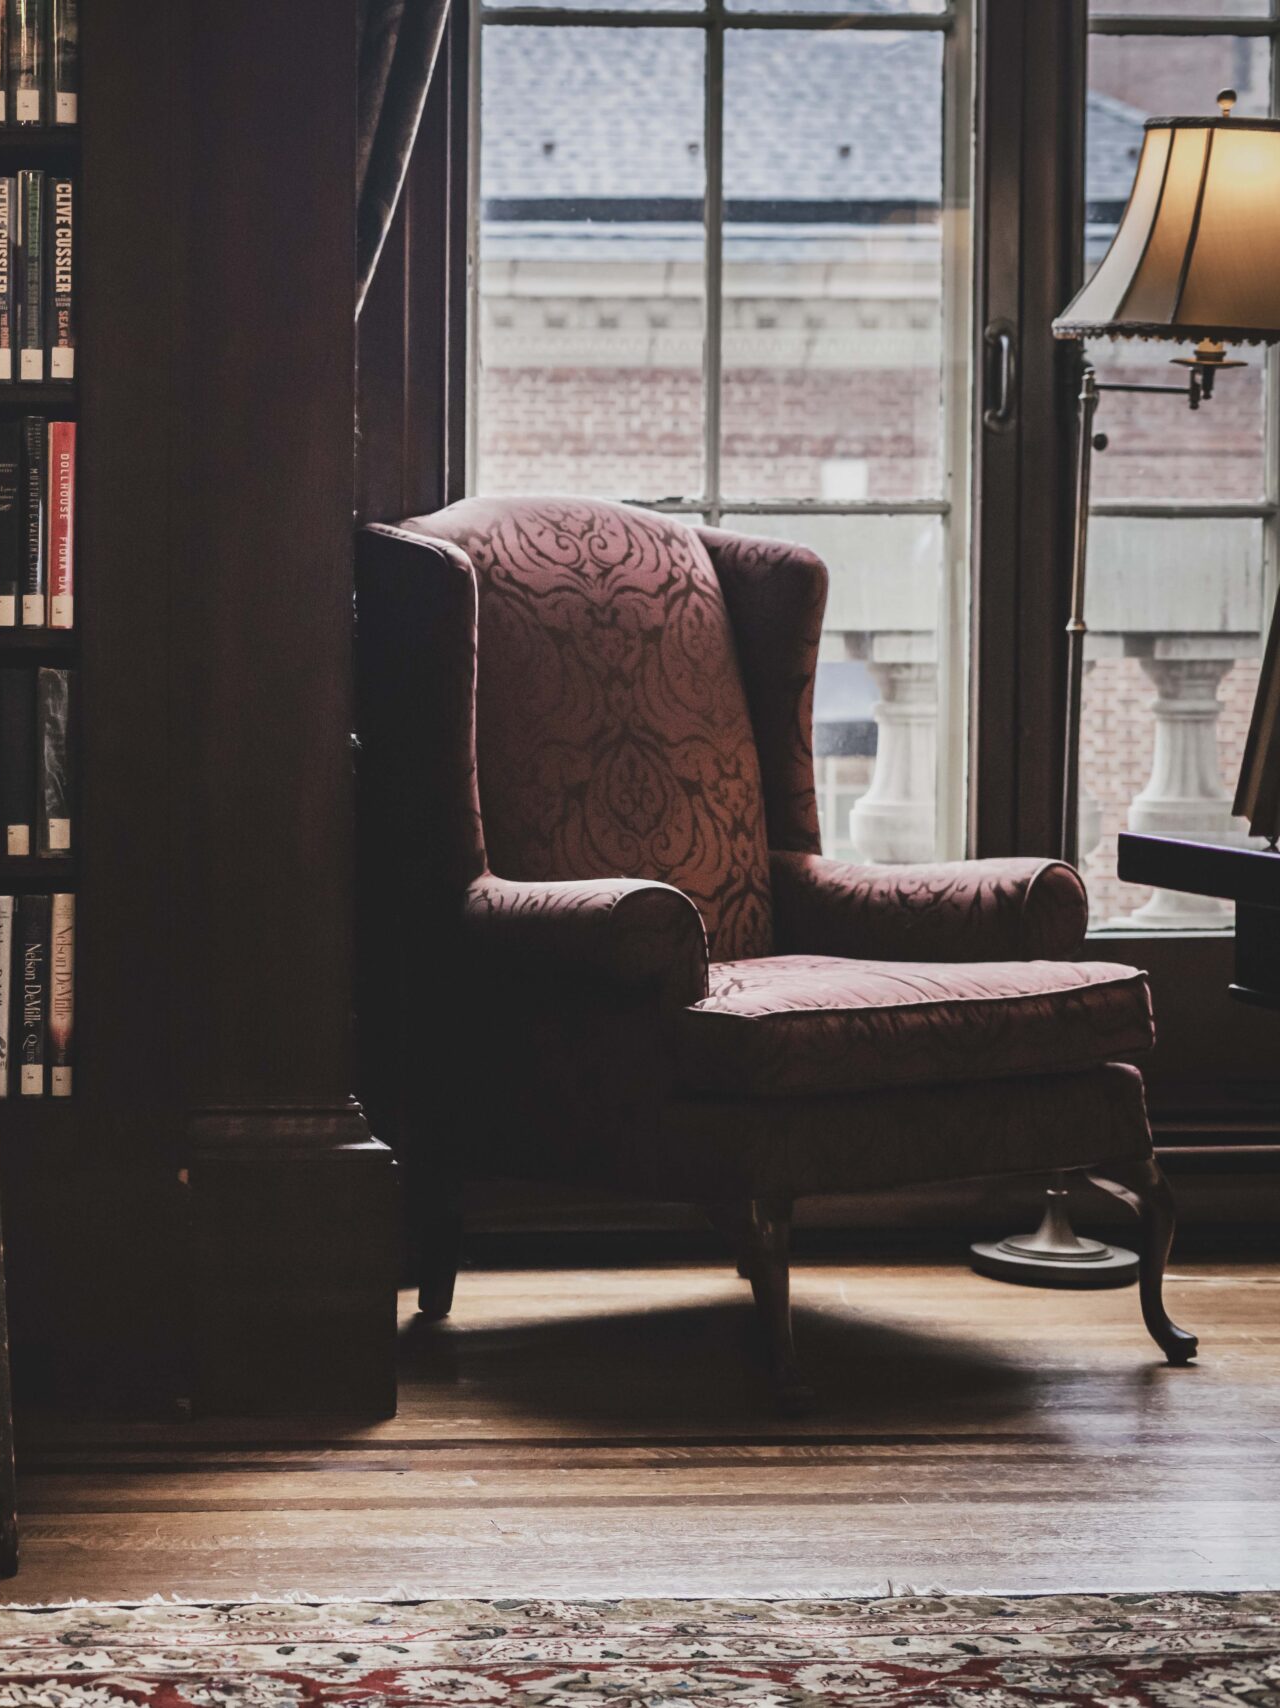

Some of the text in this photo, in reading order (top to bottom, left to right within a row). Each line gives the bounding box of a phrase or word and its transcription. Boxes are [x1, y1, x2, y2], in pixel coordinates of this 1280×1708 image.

[56, 183, 72, 330] CLIVE CUSSLER SEA
[28, 305, 38, 348] HUNTER
[58, 453, 70, 597] DOLLHOUSE FIONA DAV
[22, 943, 42, 981] Nelson
[54, 925, 72, 968] Nelson
[22, 984, 42, 1028] DeMille
[54, 972, 72, 1021] DeMille
